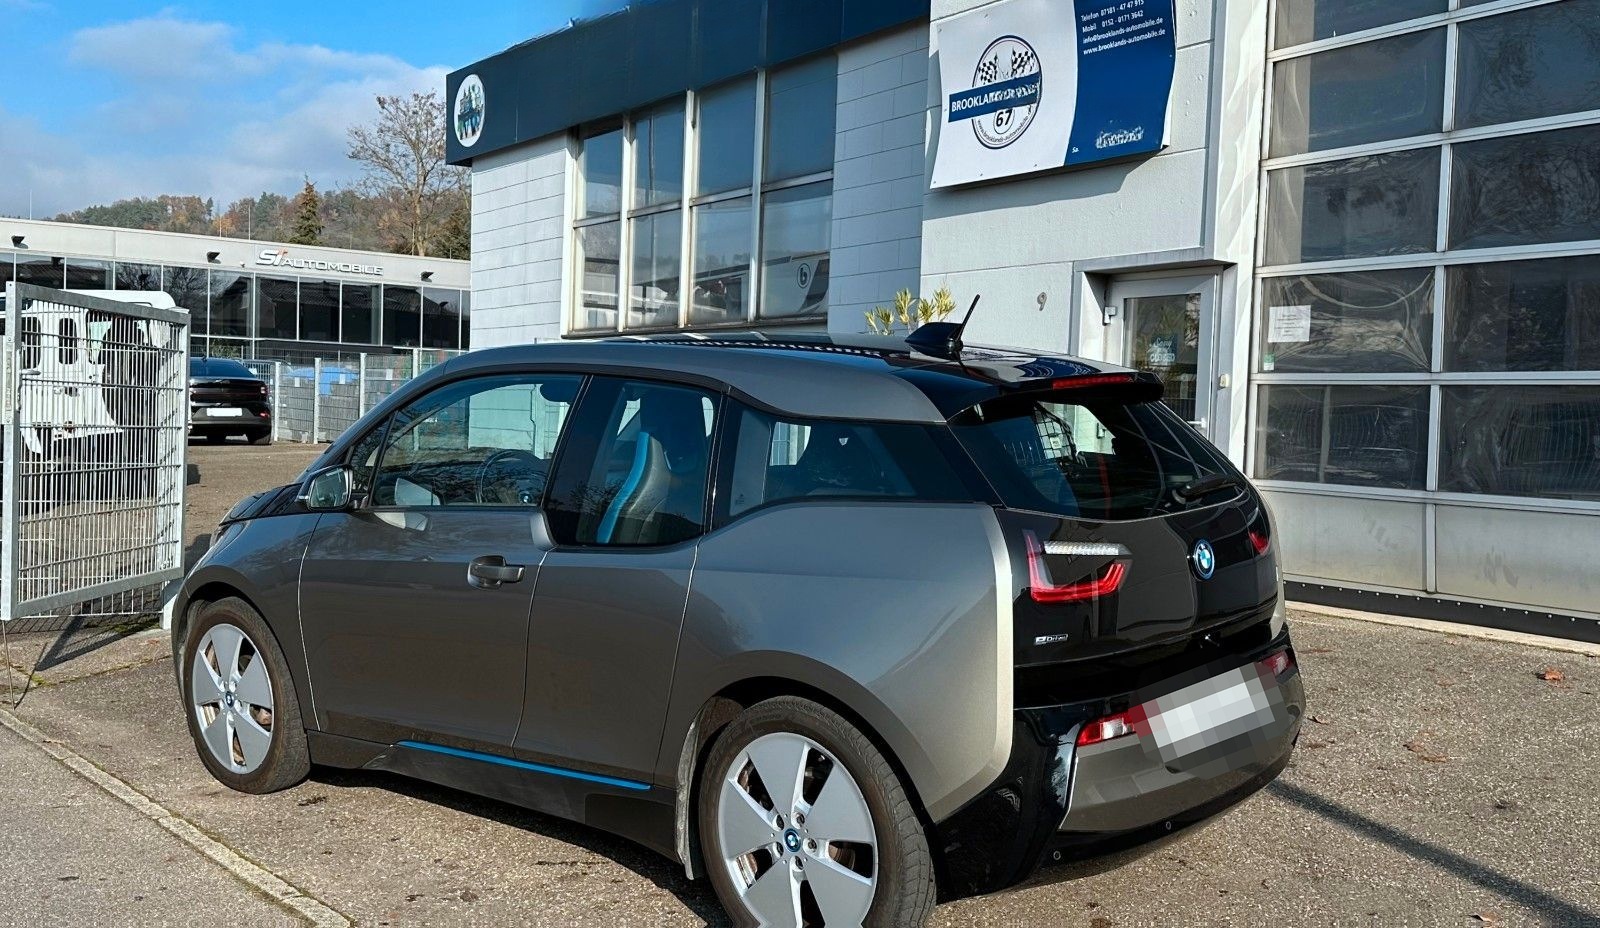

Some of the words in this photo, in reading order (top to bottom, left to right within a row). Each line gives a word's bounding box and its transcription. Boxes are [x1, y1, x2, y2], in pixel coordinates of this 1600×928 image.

[1081, 12, 1099, 22] Telefon
[1101, 6, 1115, 17] 07181
[1120, 3, 1126, 11] 47
[1127, 1, 1134, 9] 47
[1082, 23, 1097, 33] Mobil
[1102, 19, 1114, 28] 0152
[1118, 14, 1130, 23] 0171
[1083, 17, 1163, 44] info@brooklands-automobile.de
[1083, 28, 1166, 55] www.brooklands-automobile.de
[996, 109, 1012, 127] 67
[1037, 292, 1047, 312] 9
